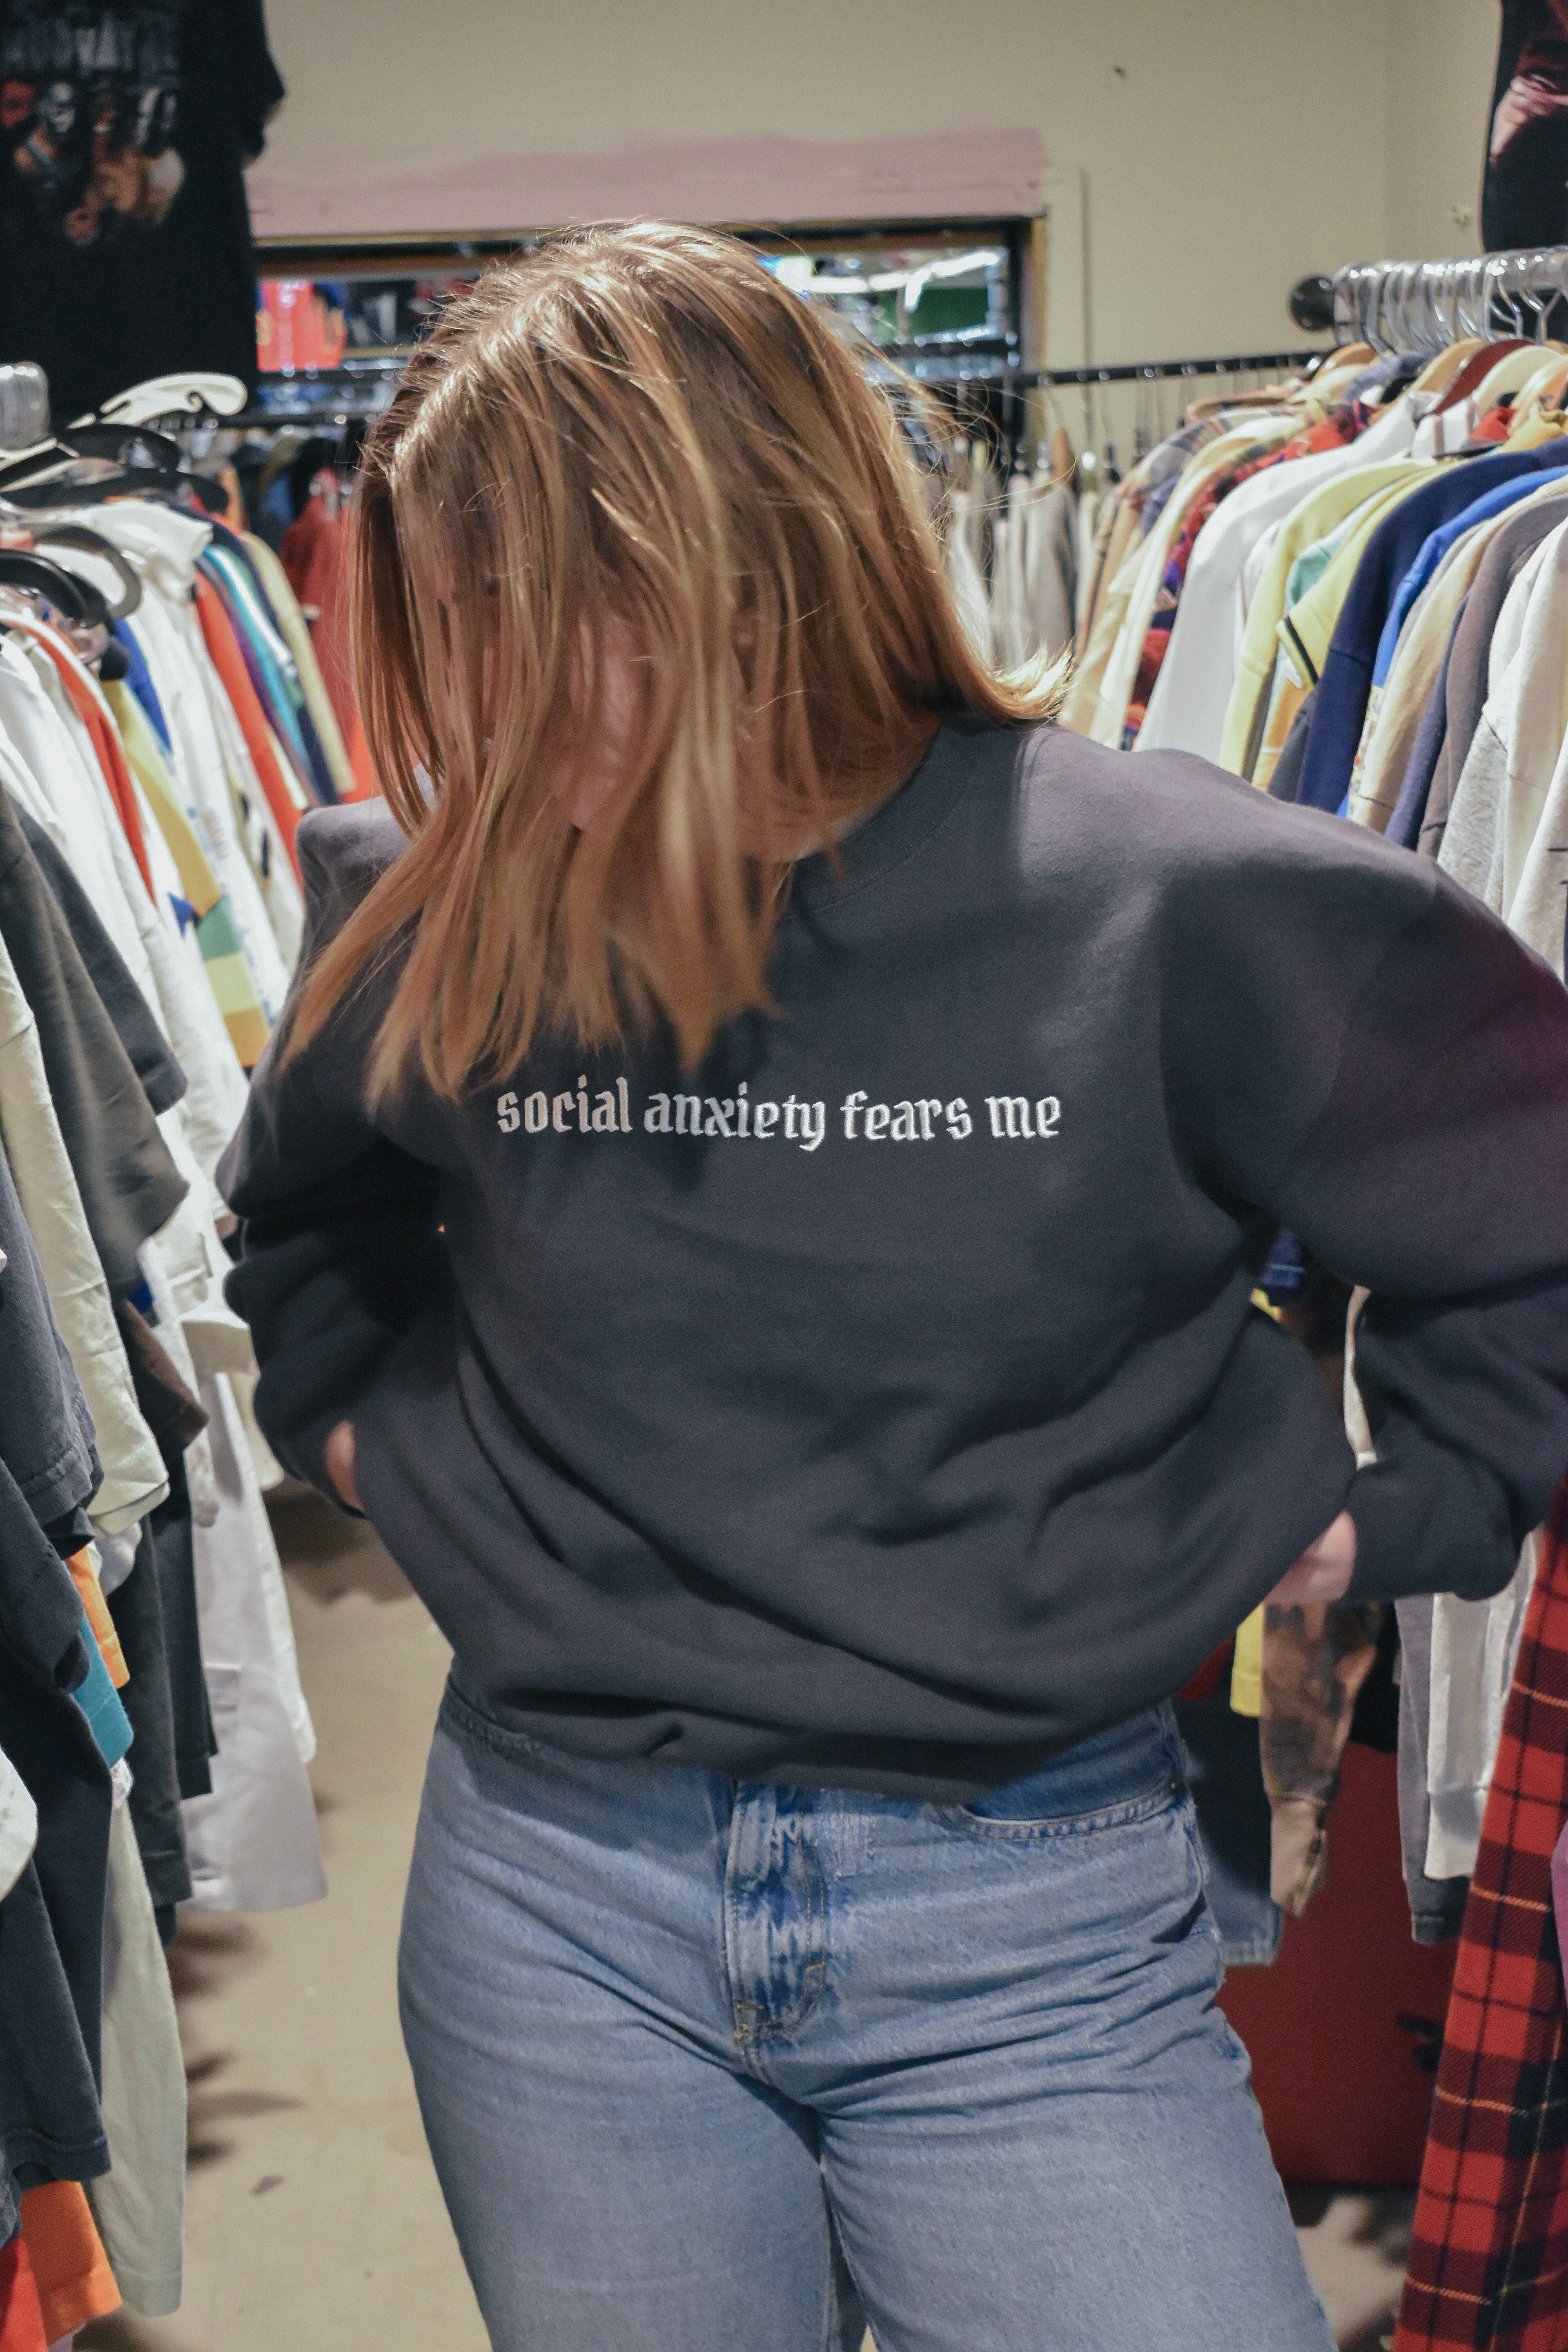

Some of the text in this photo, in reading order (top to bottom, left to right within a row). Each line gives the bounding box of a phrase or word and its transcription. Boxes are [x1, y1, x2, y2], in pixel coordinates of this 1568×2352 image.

[497, 1076, 1061, 1152] social anxiety fears me
